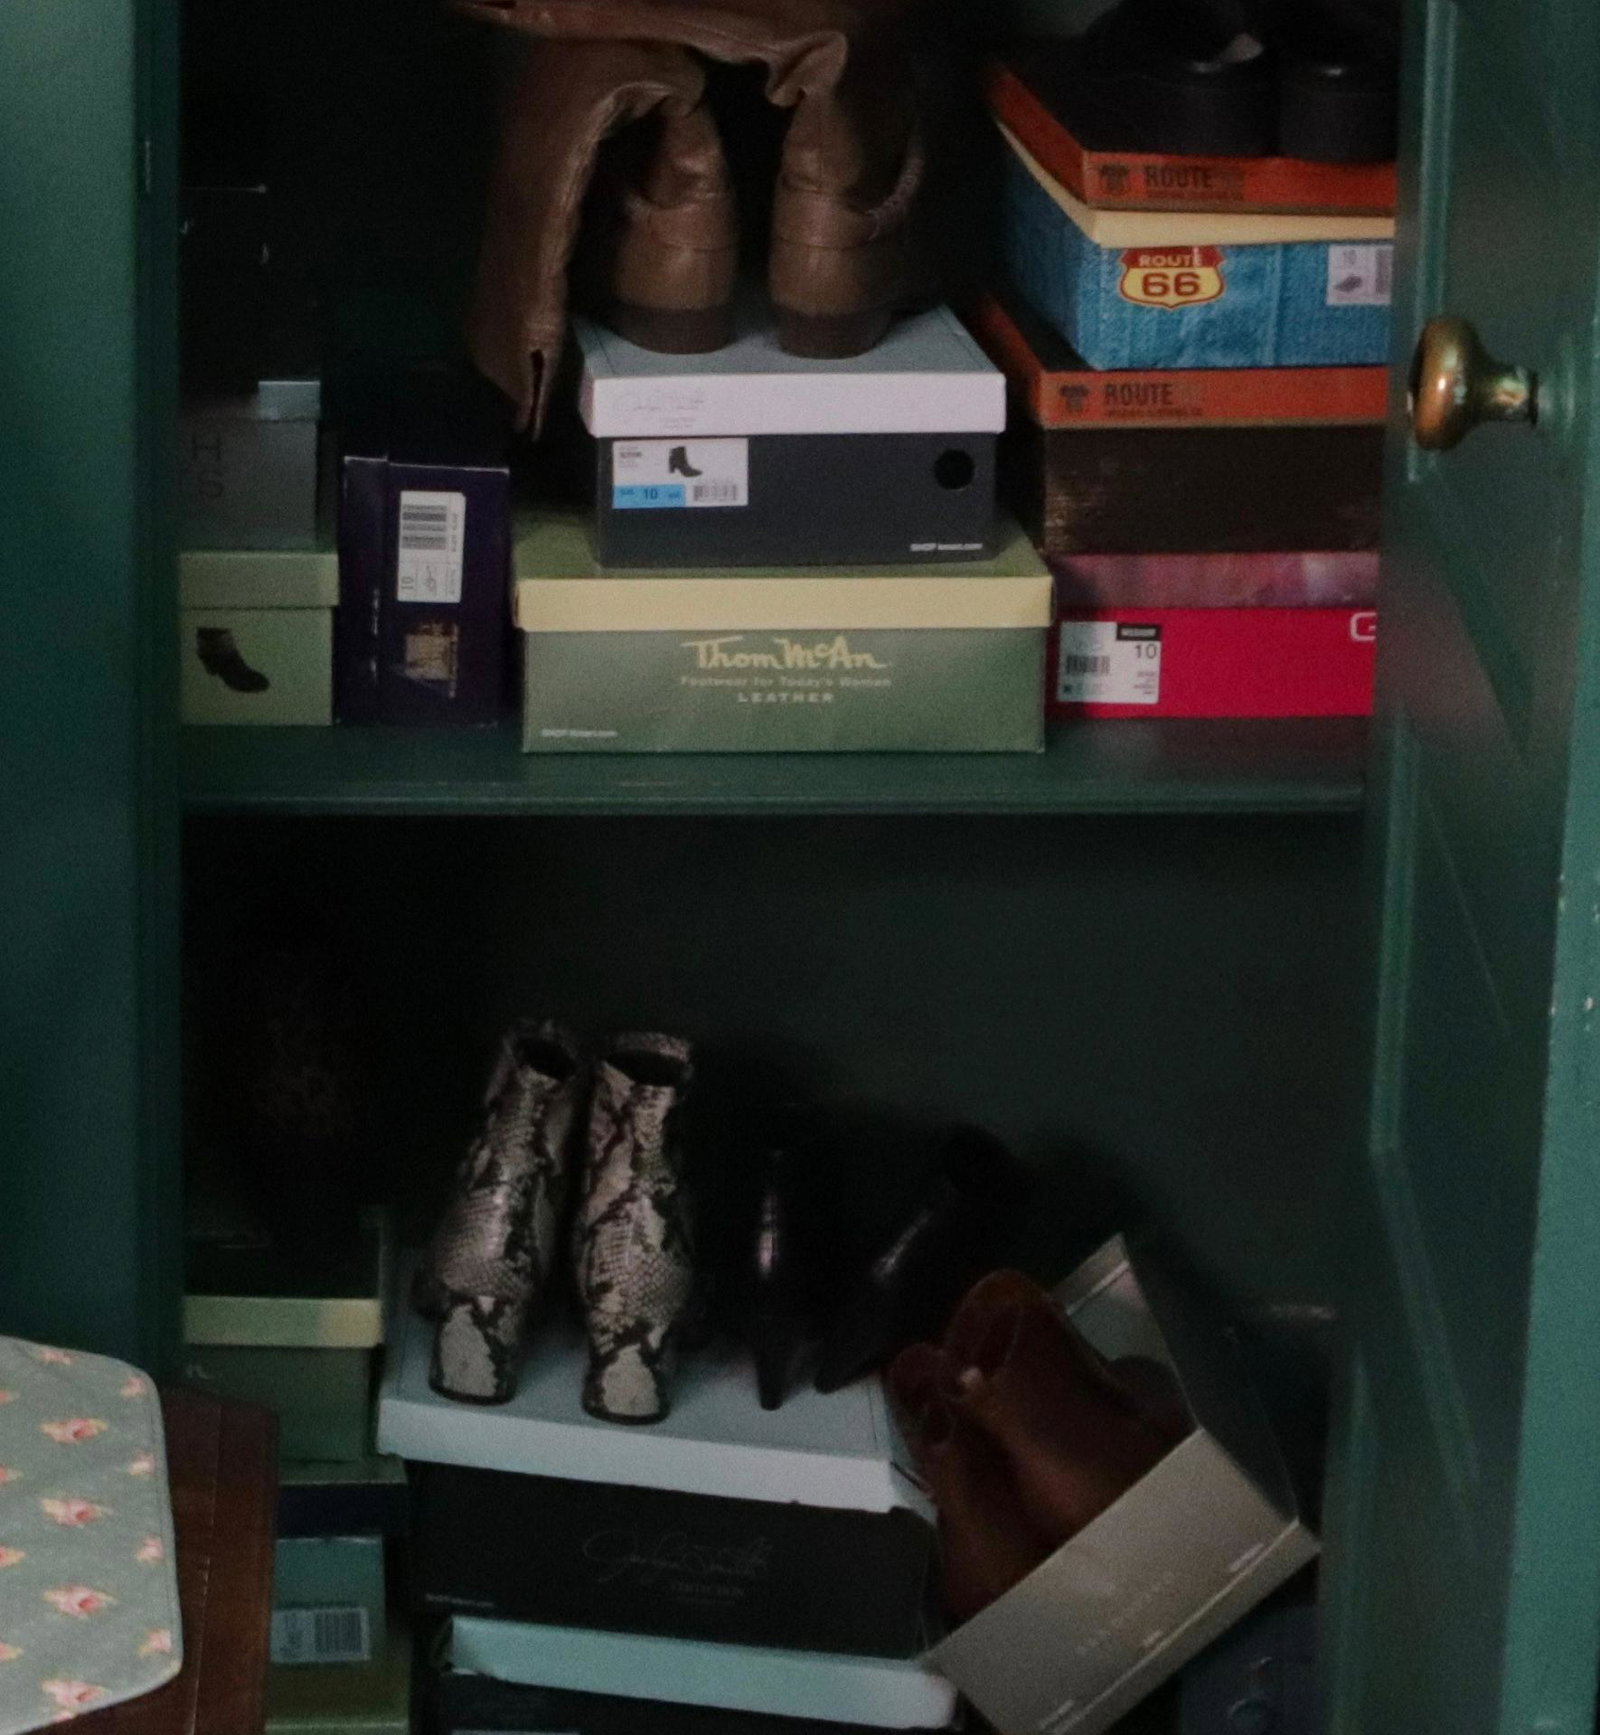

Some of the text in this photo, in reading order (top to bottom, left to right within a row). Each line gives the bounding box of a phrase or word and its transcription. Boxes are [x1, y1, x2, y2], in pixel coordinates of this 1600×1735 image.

[1145, 163, 1214, 189] ROUTE
[1139, 253, 1203, 267] ROUTE
[1142, 271, 1201, 297] 66
[1104, 383, 1174, 406] ROUTE
[643, 487, 659, 500] 10
[679, 634, 888, 669] Thom McAn
[1135, 642, 1158, 660] 10
[753, 675, 773, 688] for
[737, 691, 836, 704] LEATHER
